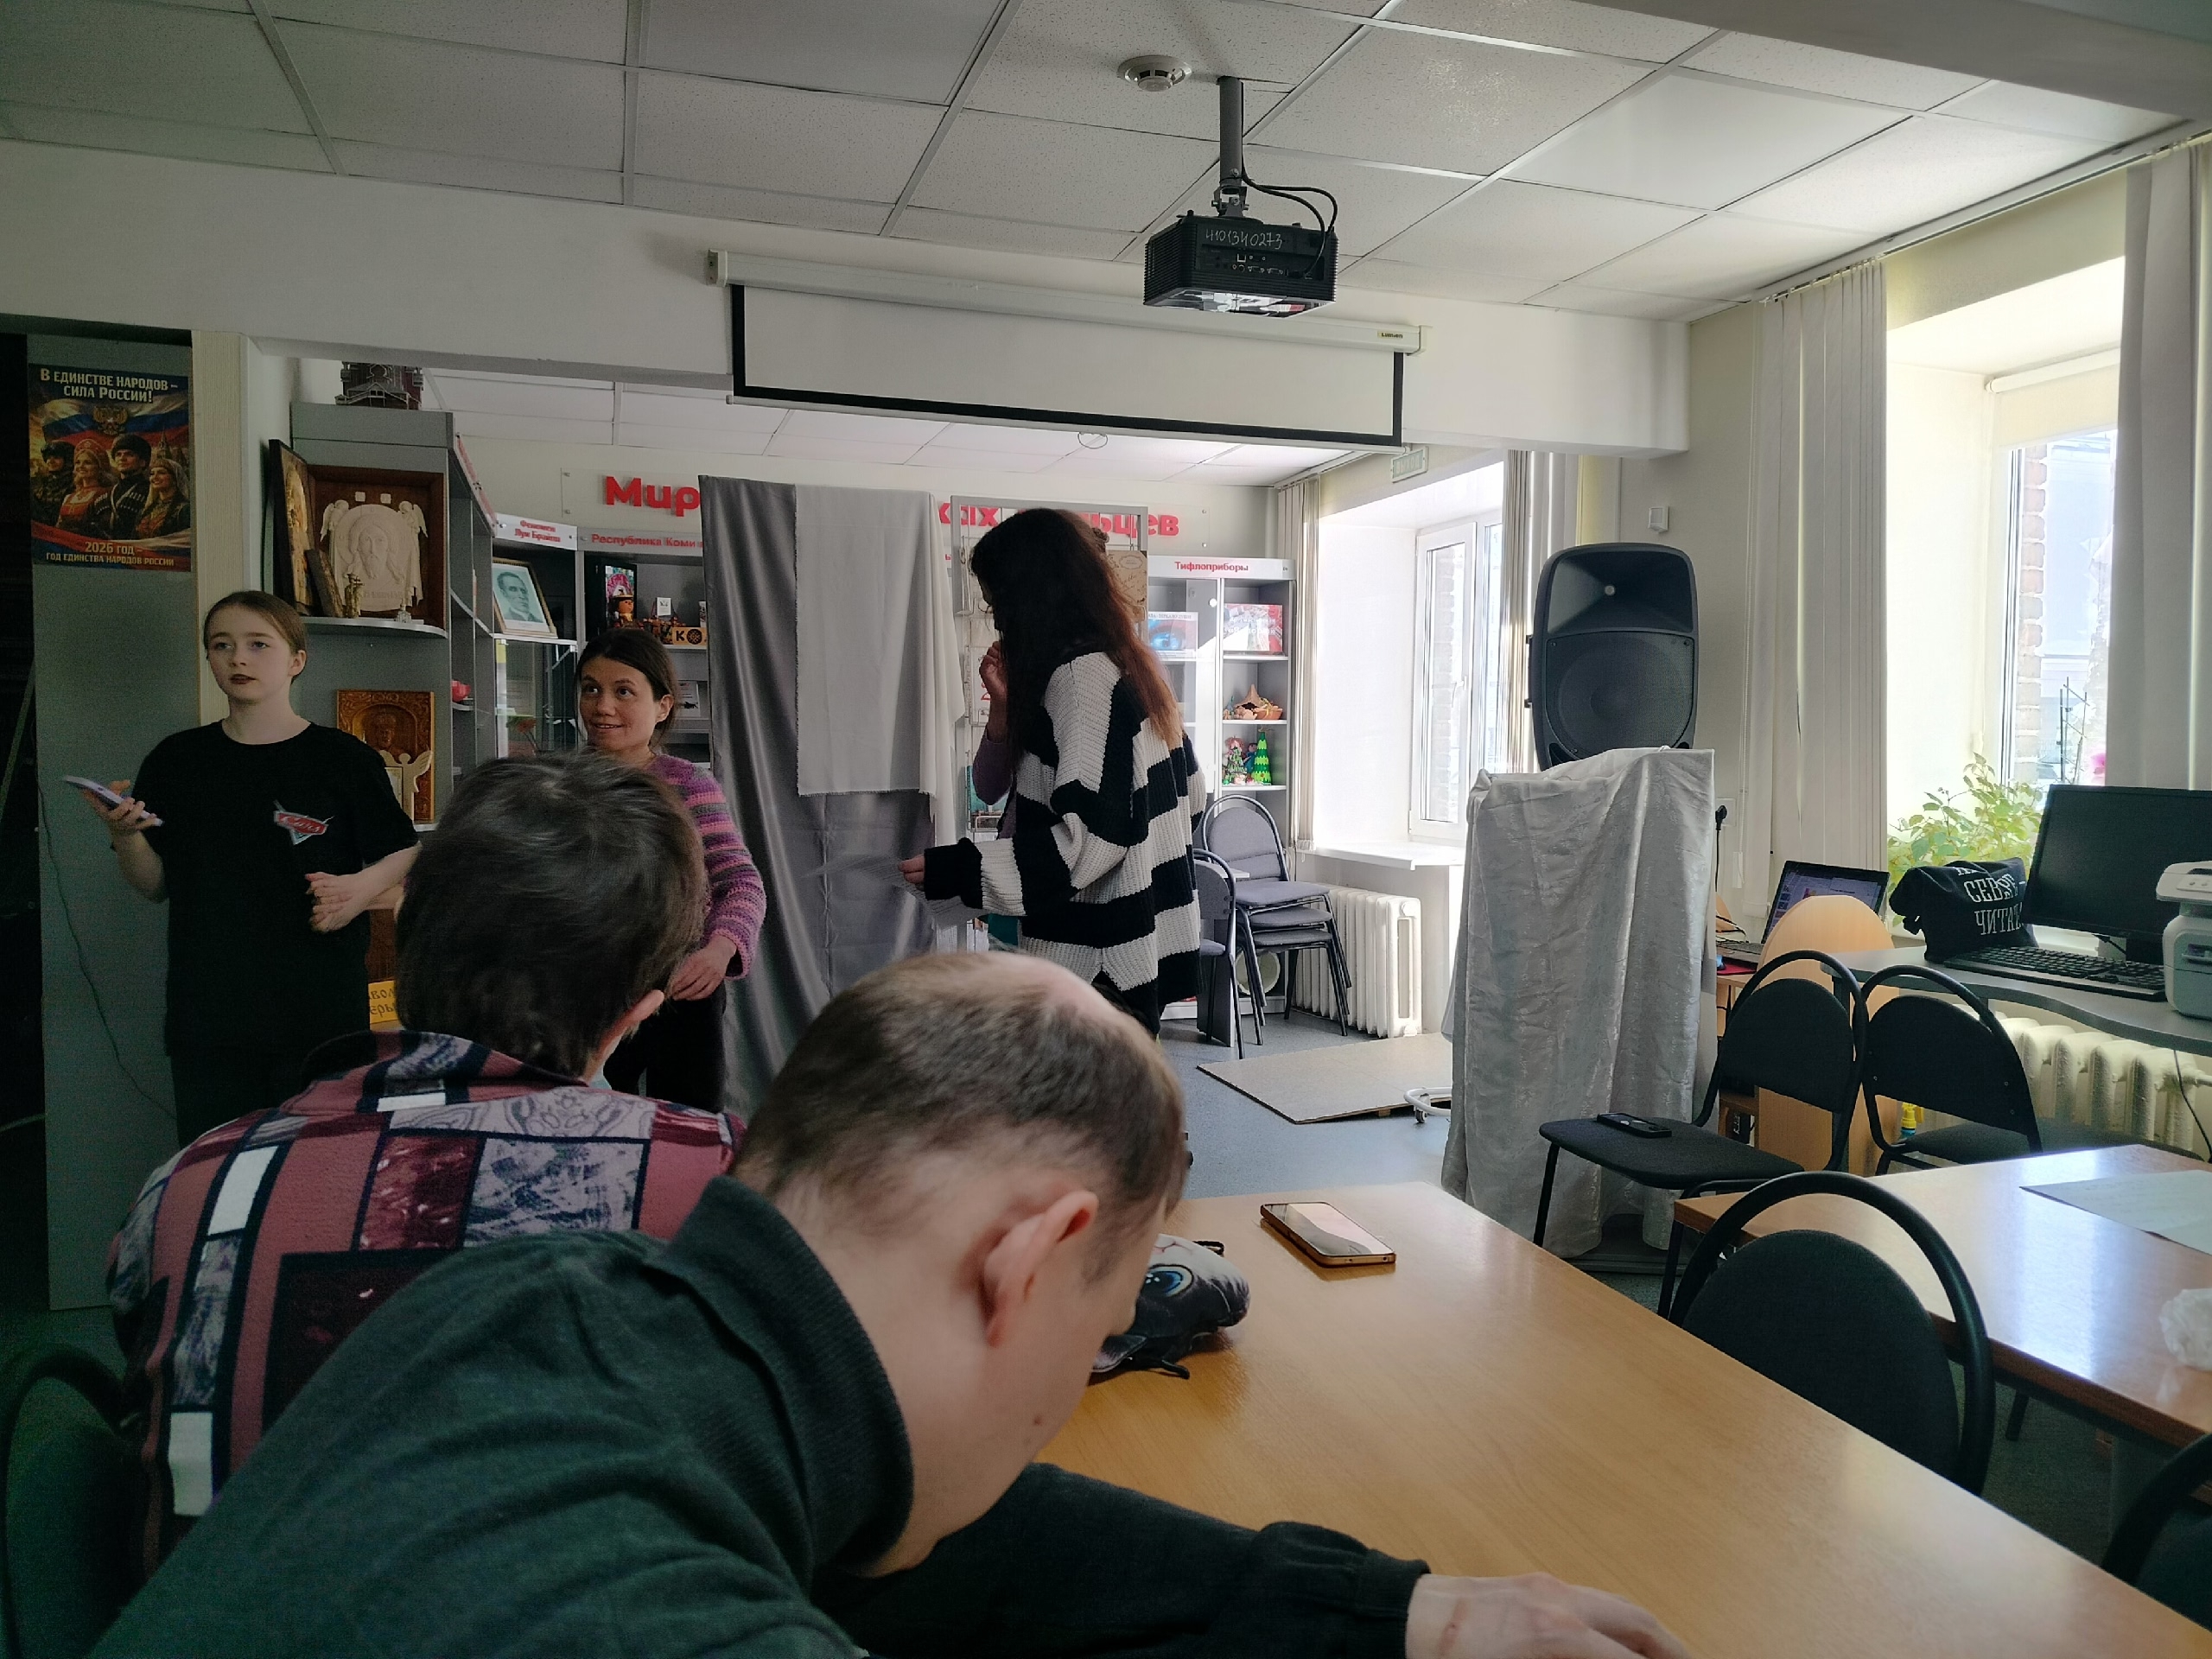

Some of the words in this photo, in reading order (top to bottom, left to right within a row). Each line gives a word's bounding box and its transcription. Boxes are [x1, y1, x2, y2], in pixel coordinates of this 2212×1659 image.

[40, 367, 51, 381] В
[54, 371, 114, 386] ЕДИНСТВЕ
[116, 376, 168, 391] НАРОДОВ
[63, 385, 96, 398] СИЛА
[605, 475, 701, 517] Мир
[85, 541, 114, 553] 2026
[591, 533, 662, 546] Республика
[665, 537, 696, 548] Коми
[46, 552, 61, 562] ГОД
[63, 553, 104, 563] ЕДИНСТВА
[106, 556, 143, 565] НАРОДОВ
[144, 557, 174, 566] РОССИИ
[1174, 561, 1249, 572] Тифлоприборы
